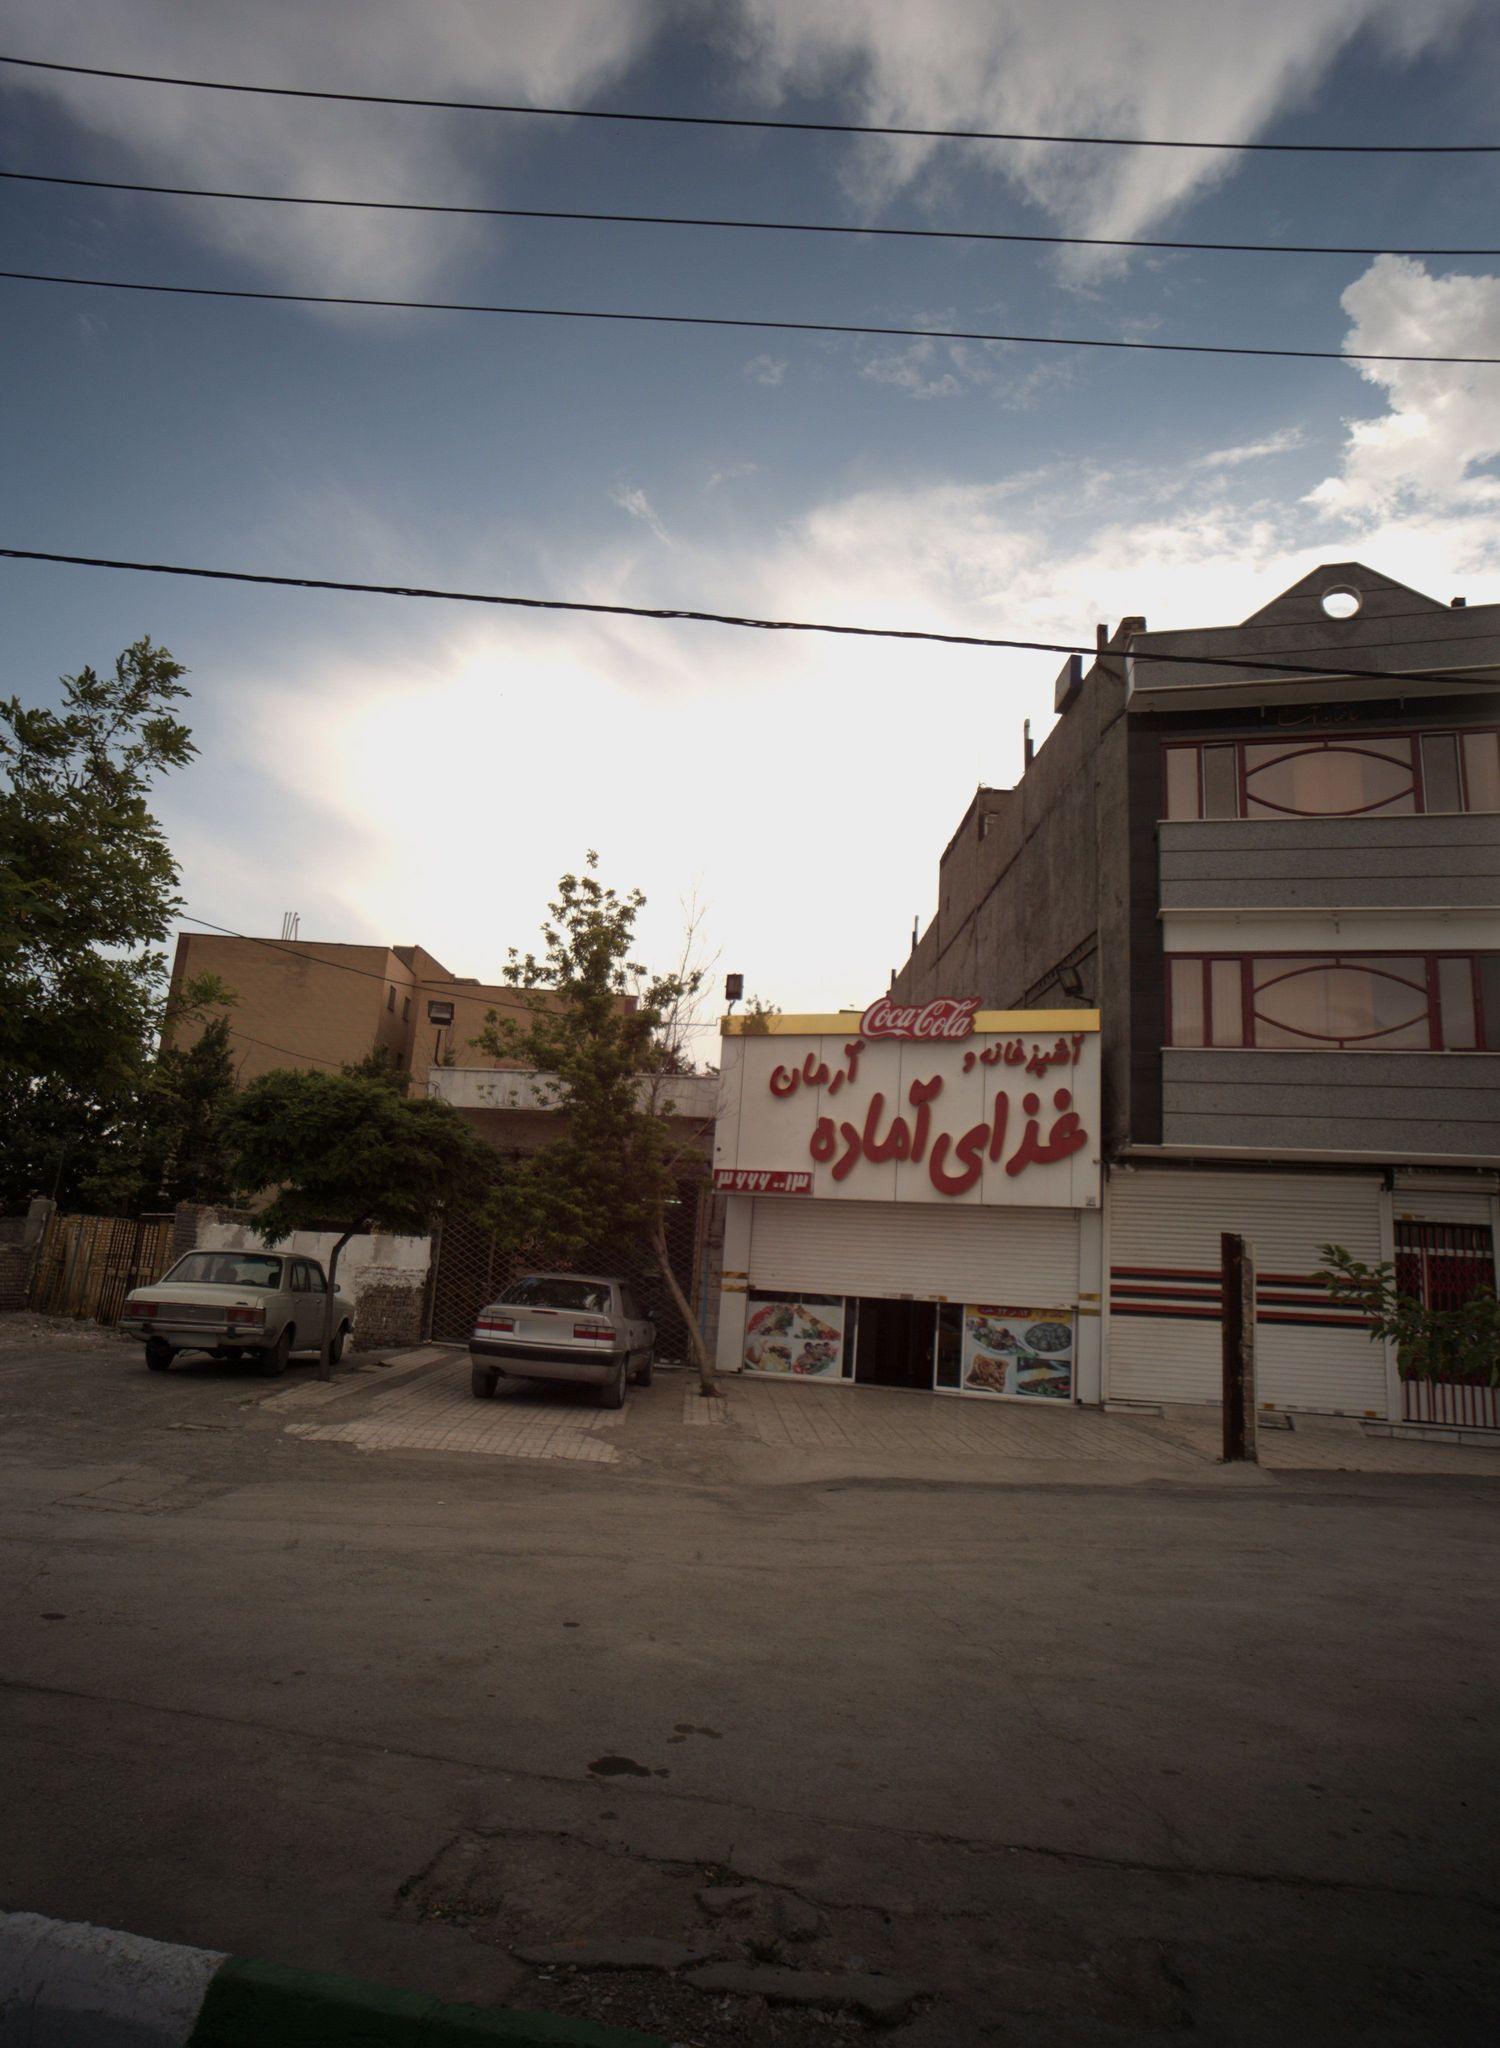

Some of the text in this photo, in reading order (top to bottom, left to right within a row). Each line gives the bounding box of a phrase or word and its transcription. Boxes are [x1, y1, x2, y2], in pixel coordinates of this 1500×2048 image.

[862, 999, 978, 1037] Coca-Cola
[769, 1039, 865, 1097] آرمان
[963, 1034, 1085, 1078] آشپزخانه و
[809, 1075, 1088, 1196] غذای آماده
